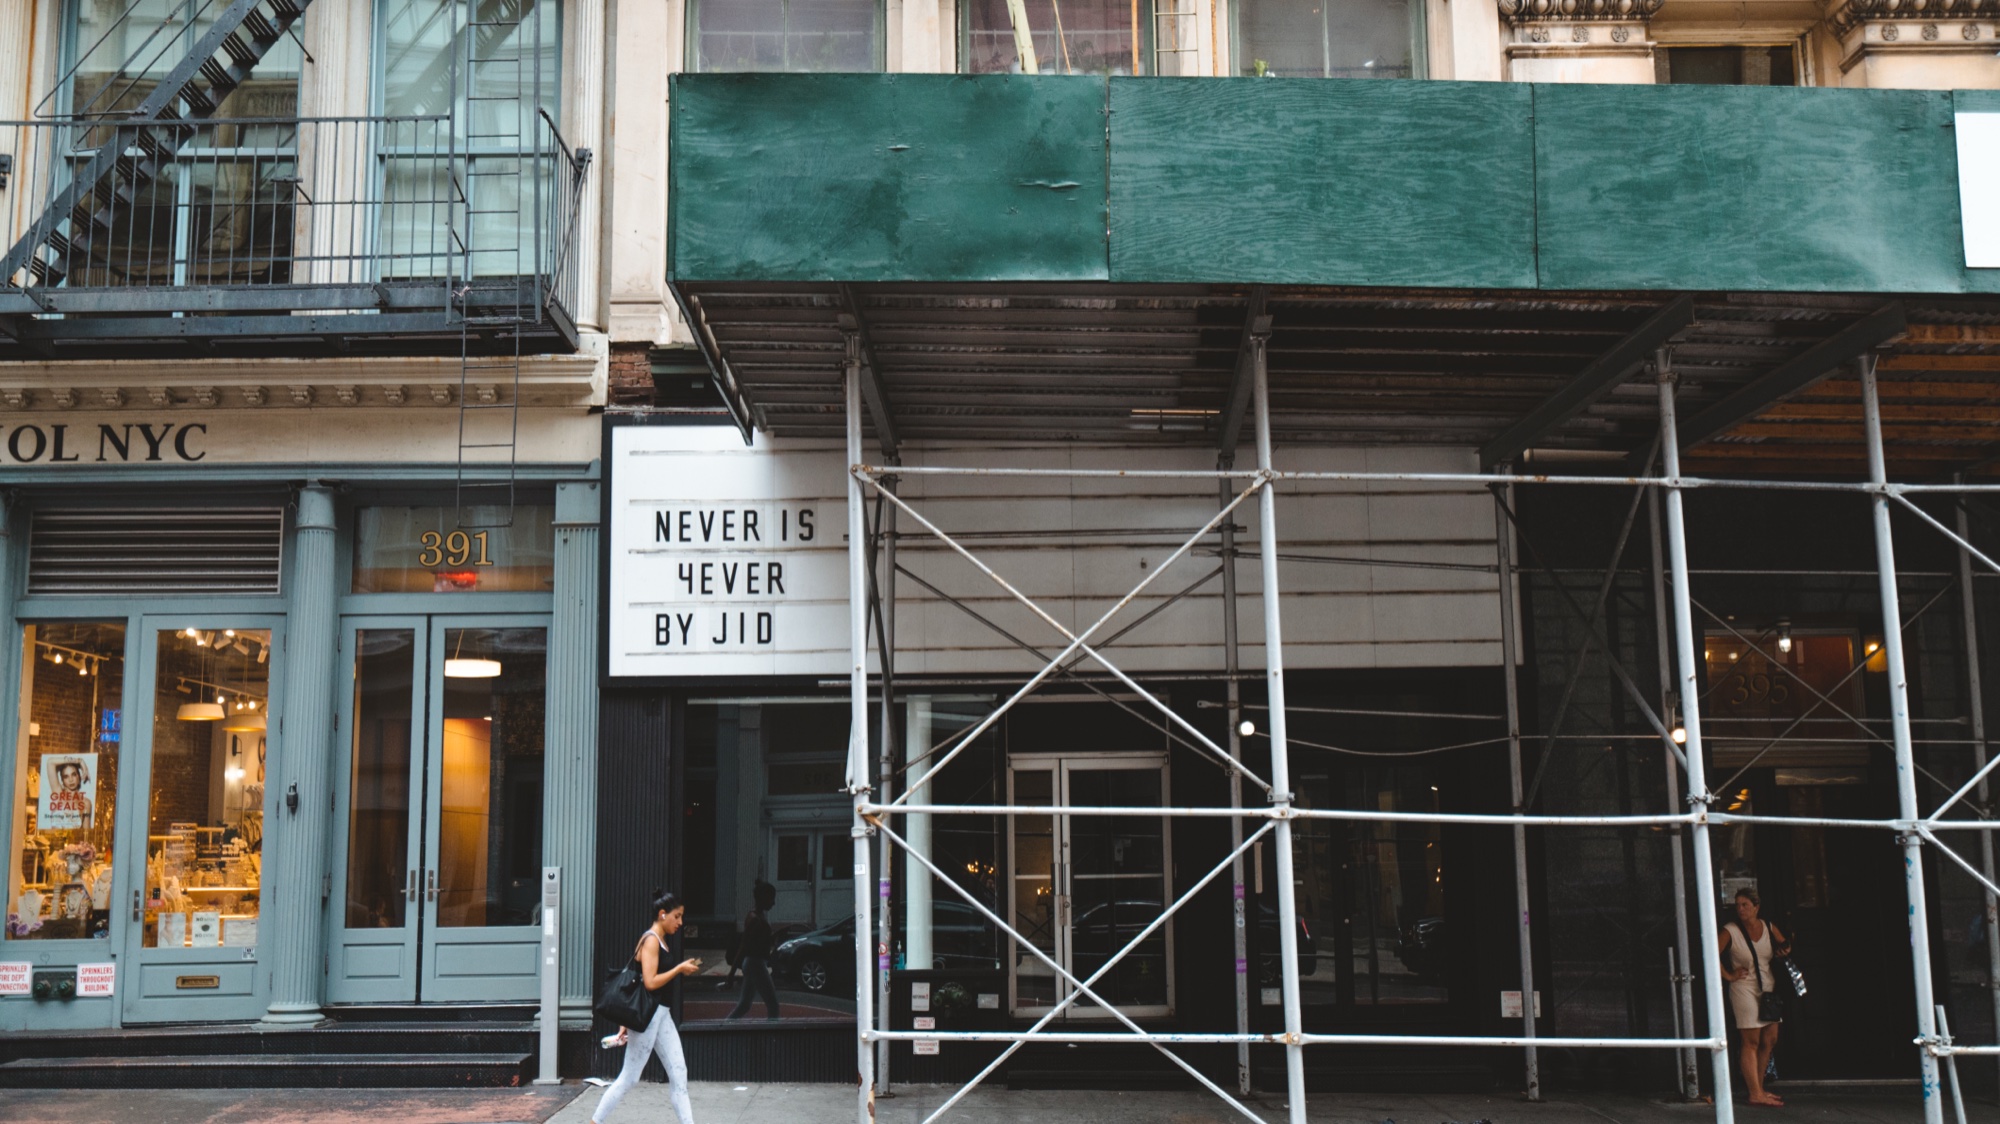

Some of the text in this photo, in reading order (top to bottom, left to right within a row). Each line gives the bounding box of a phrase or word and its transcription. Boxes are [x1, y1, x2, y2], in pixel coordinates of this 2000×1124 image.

[0, 423, 207, 462] OL NYC
[655, 509, 814, 542] NEVER IS
[419, 530, 493, 567] 391
[678, 562, 785, 595] 4EVER
[655, 612, 772, 646] BY JID
[1731, 673, 1788, 705] 395
[49, 801, 85, 811] DEALS
[50, 792, 86, 801] GREAT
[80, 975, 114, 983] THROUGHOUT
[81, 967, 113, 975] SPRINKLERS
[84, 984, 109, 992] BUILDING
